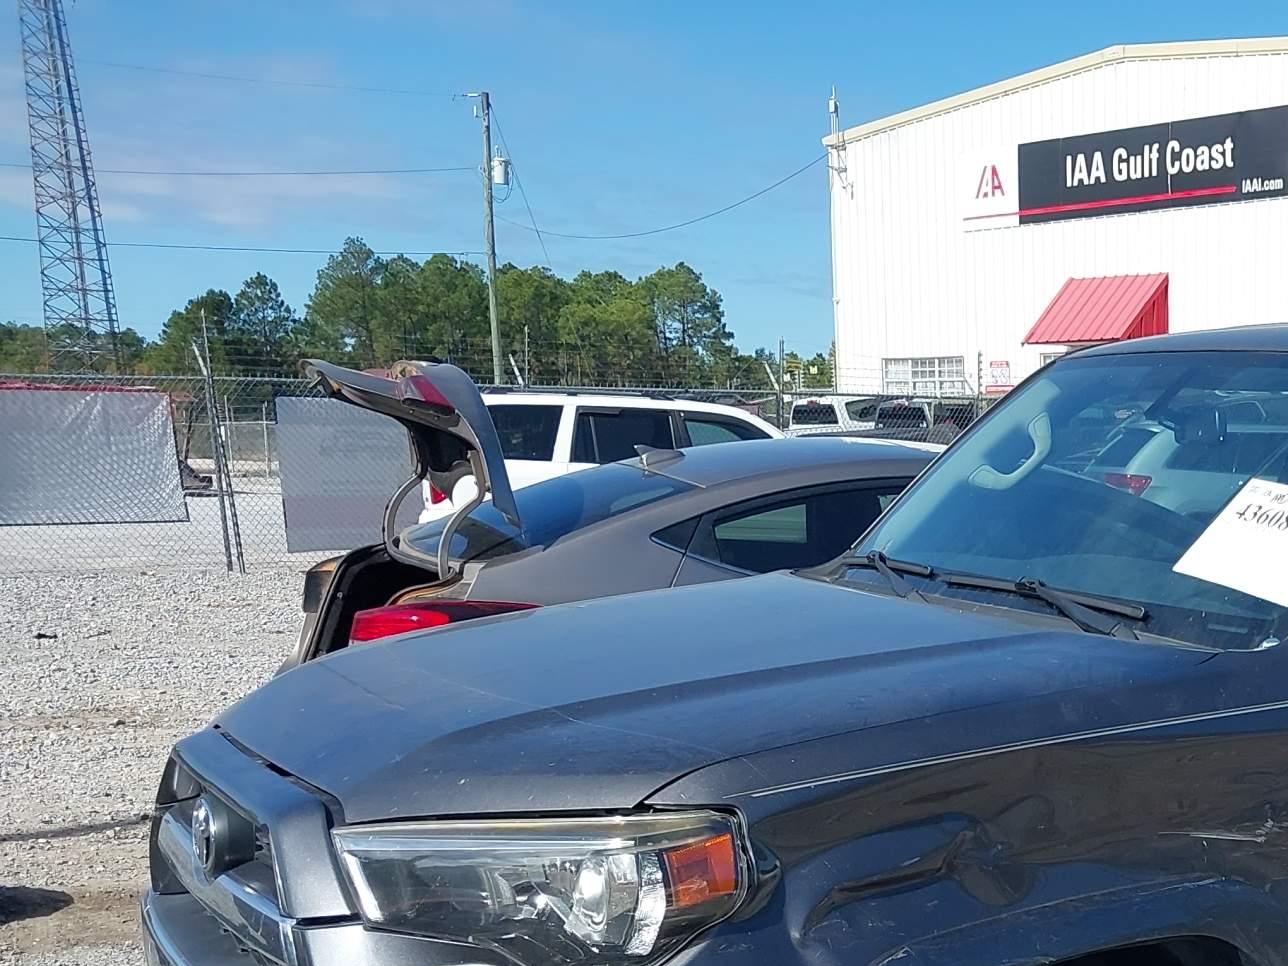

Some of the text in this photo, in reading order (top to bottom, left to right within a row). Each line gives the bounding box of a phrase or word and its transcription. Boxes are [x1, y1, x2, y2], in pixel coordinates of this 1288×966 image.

[1066, 136, 1234, 187] IAA Gulf Coast
[1241, 177, 1284, 194] IAAI.com
